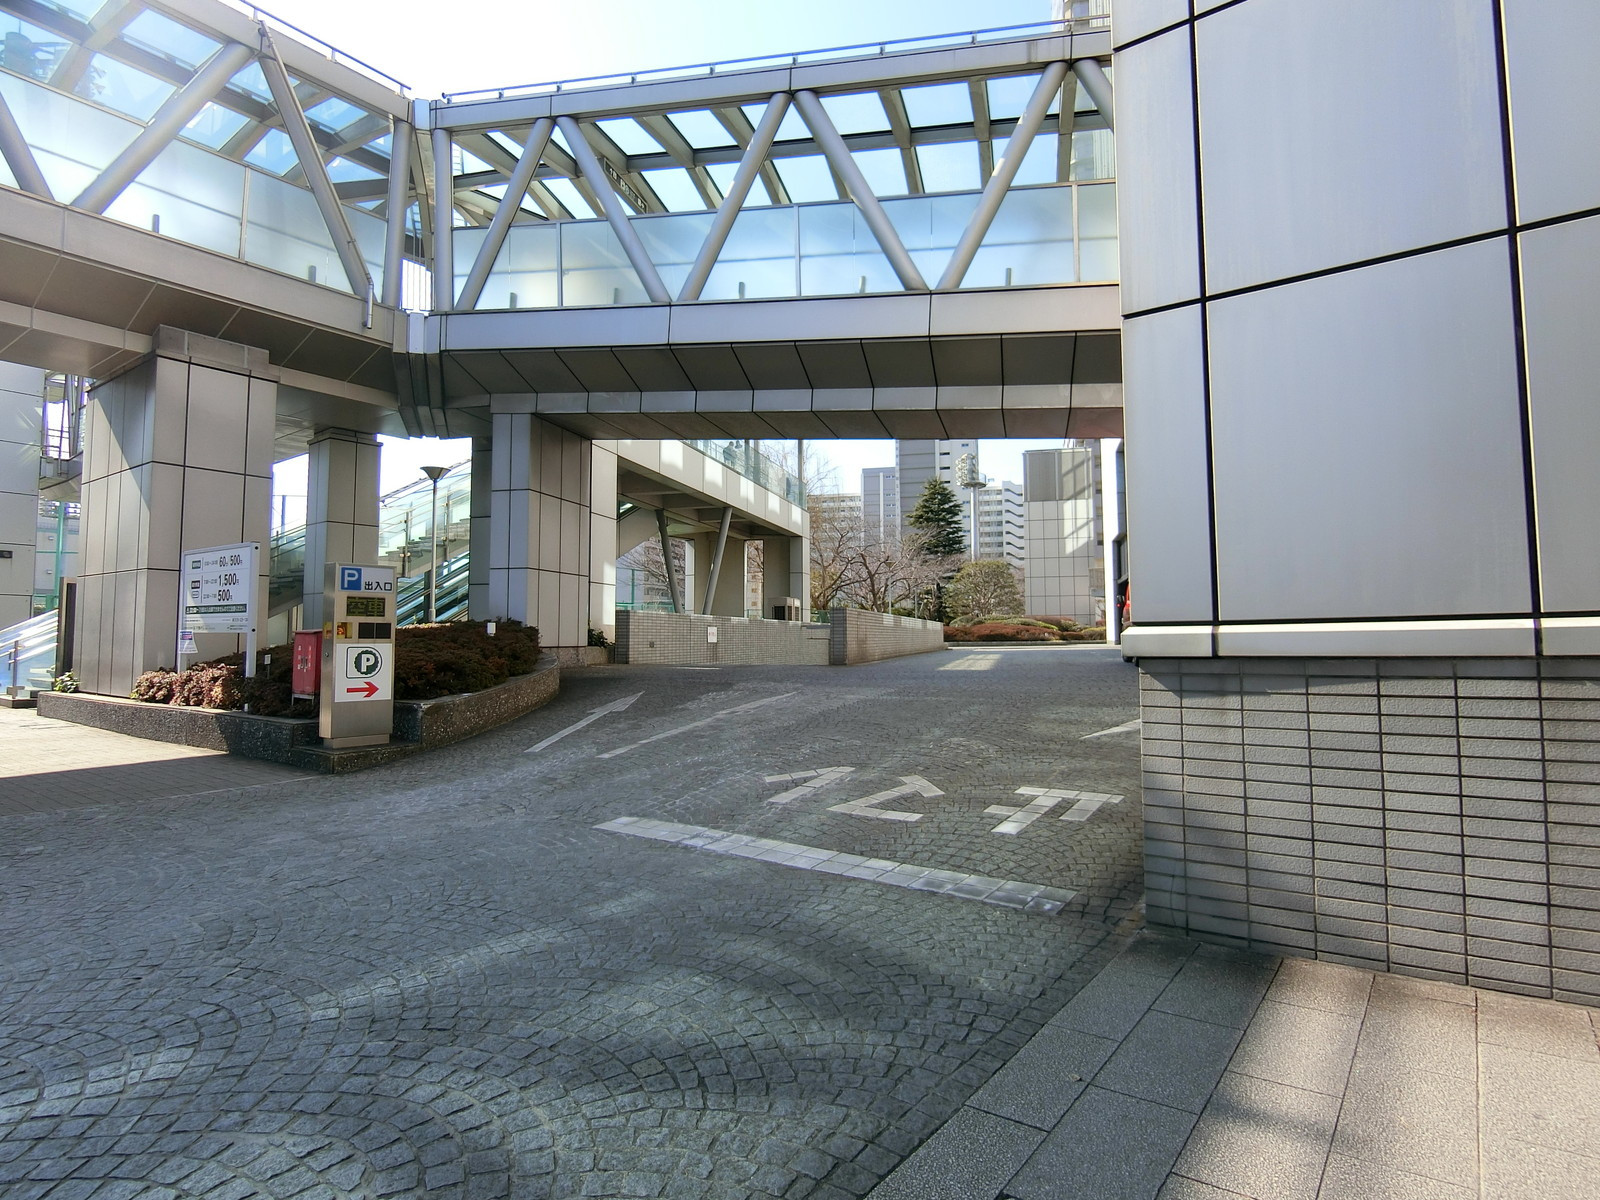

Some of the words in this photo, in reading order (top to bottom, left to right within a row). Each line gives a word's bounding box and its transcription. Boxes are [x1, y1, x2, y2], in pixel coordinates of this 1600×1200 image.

[344, 569, 359, 588] P
[364, 581, 393, 591] 出入口
[361, 653, 376, 672] P
